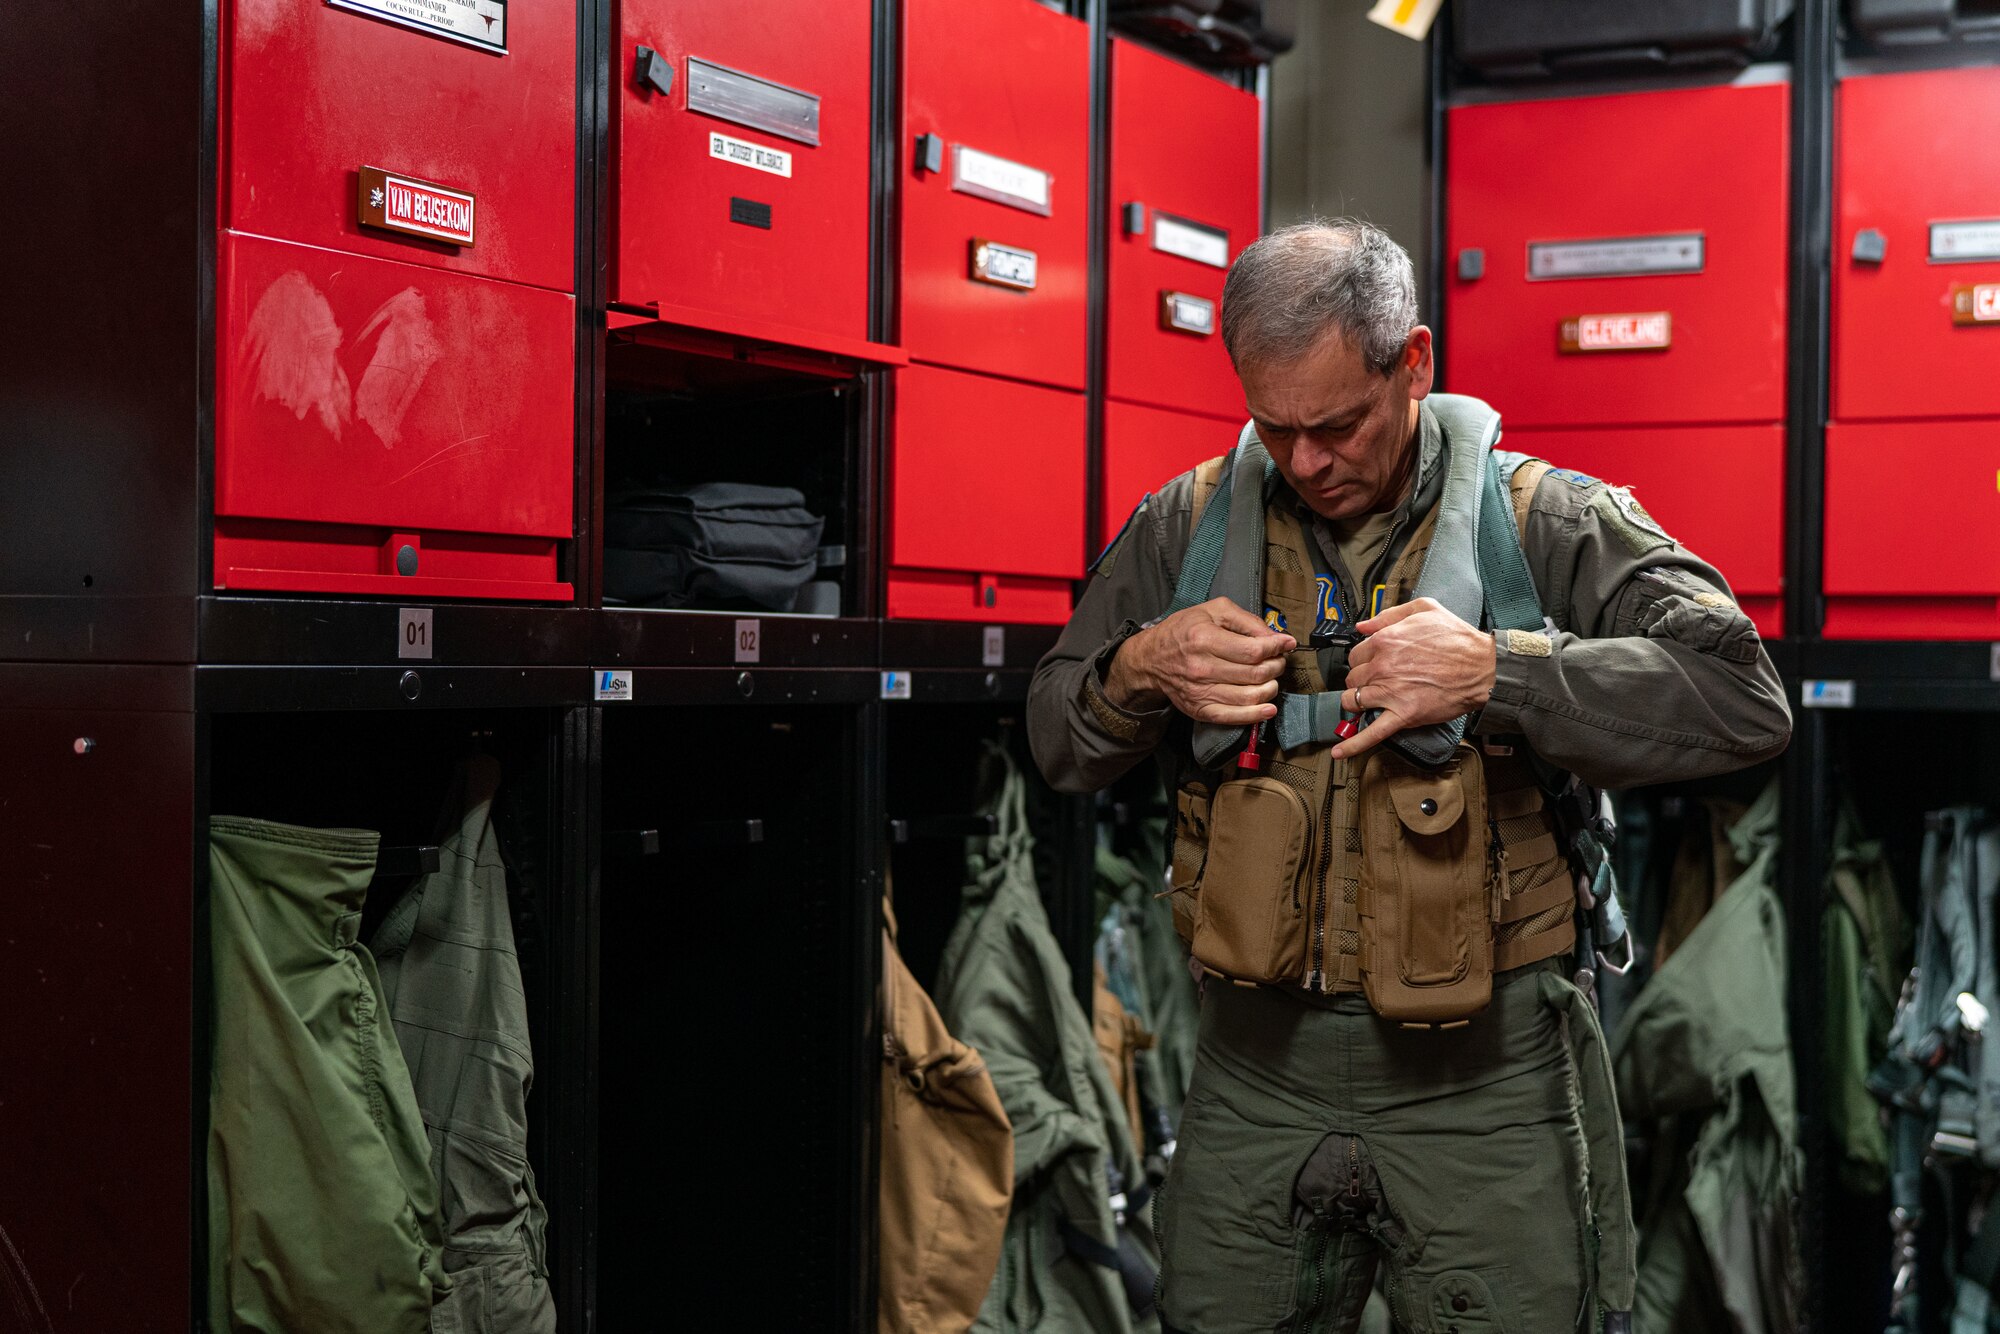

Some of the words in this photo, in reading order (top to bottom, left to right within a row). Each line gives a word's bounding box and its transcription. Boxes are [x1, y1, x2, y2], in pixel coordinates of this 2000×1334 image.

[386, 1, 408, 13] COCKS
[390, 186, 412, 219] VAN
[413, 191, 470, 233] BEUSEKOM
[406, 621, 426, 646] 01
[740, 630, 756, 651] 02
